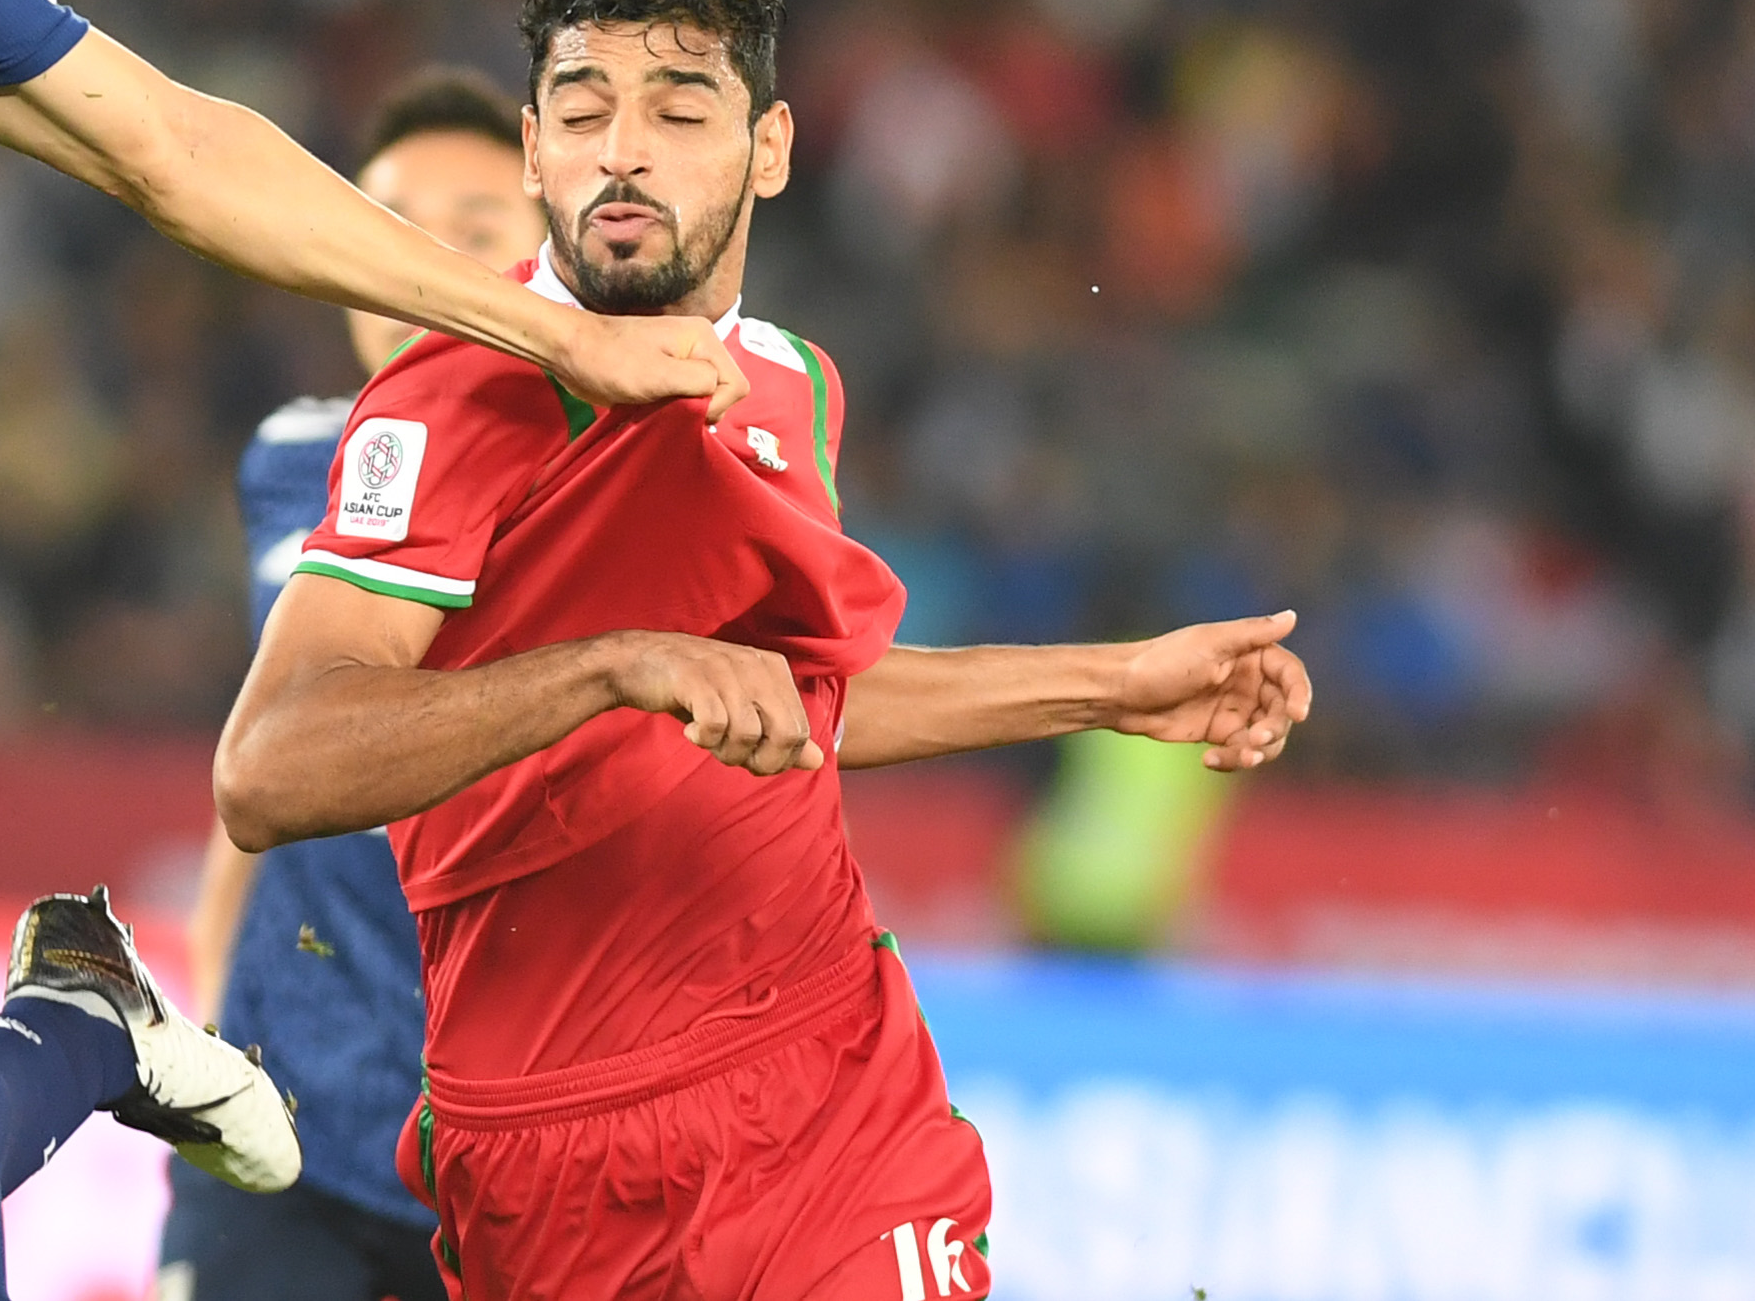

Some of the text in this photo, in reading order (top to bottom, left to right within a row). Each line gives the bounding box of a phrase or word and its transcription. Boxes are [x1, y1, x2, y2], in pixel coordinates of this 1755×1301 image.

[362, 492, 381, 503] AFC
[344, 502, 403, 517] ASIAN CUP
[879, 1217, 972, 1301] 16
